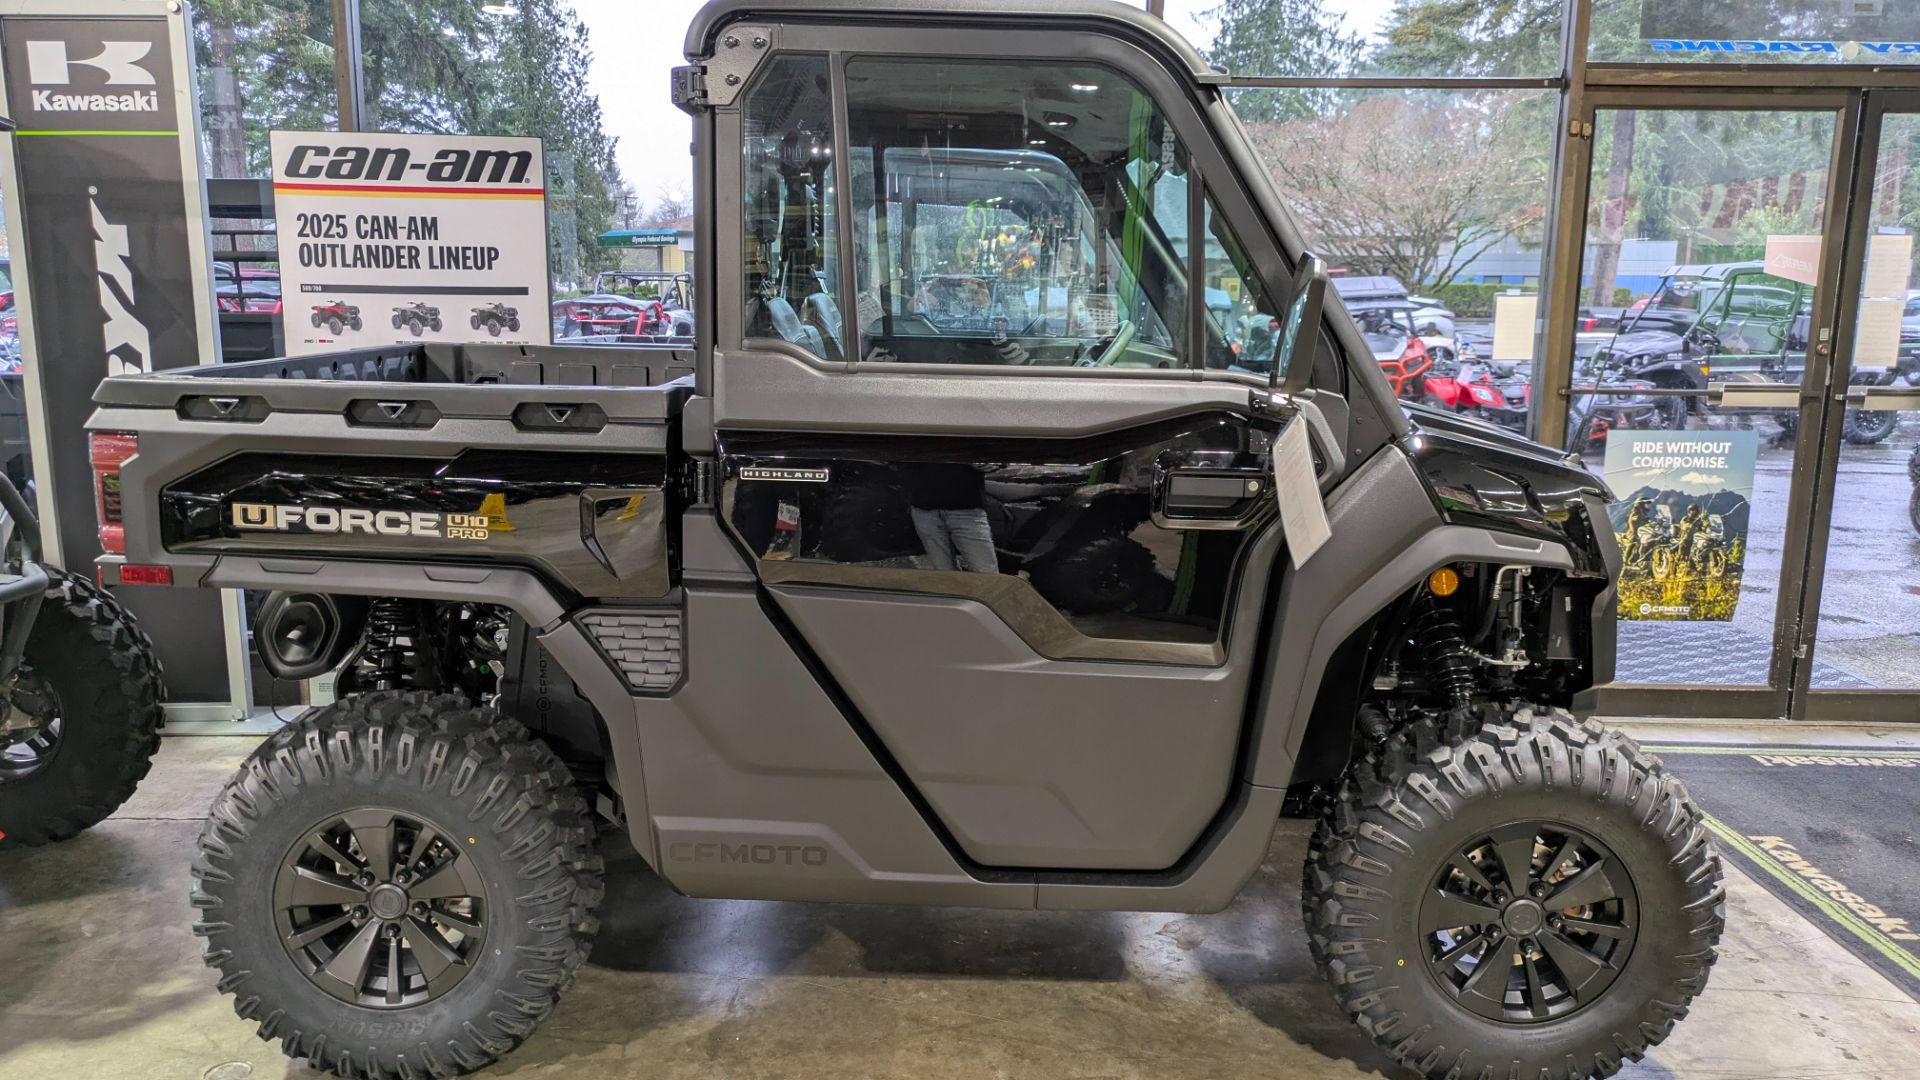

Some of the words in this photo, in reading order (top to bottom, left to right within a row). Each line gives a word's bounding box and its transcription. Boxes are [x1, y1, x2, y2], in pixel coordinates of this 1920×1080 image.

[31, 90, 159, 112] Kawasaki
[284, 145, 532, 184] can-am
[296, 213, 348, 239] 2025
[355, 214, 439, 241] CAN-AM
[298, 242, 421, 270] OUTLANDER
[428, 245, 500, 271] LINEUP
[1632, 441, 1663, 454] RIDE
[1666, 441, 1732, 454] WITHOUT
[1631, 456, 1728, 469] COMPROMISE.
[744, 471, 825, 479] HIGHLAND
[447, 513, 489, 527] U10
[447, 527, 489, 540] PRO
[1751, 755, 1920, 767] awasaki
[669, 842, 828, 866] CFMOTO
[1747, 835, 1920, 940] Kawasaki
